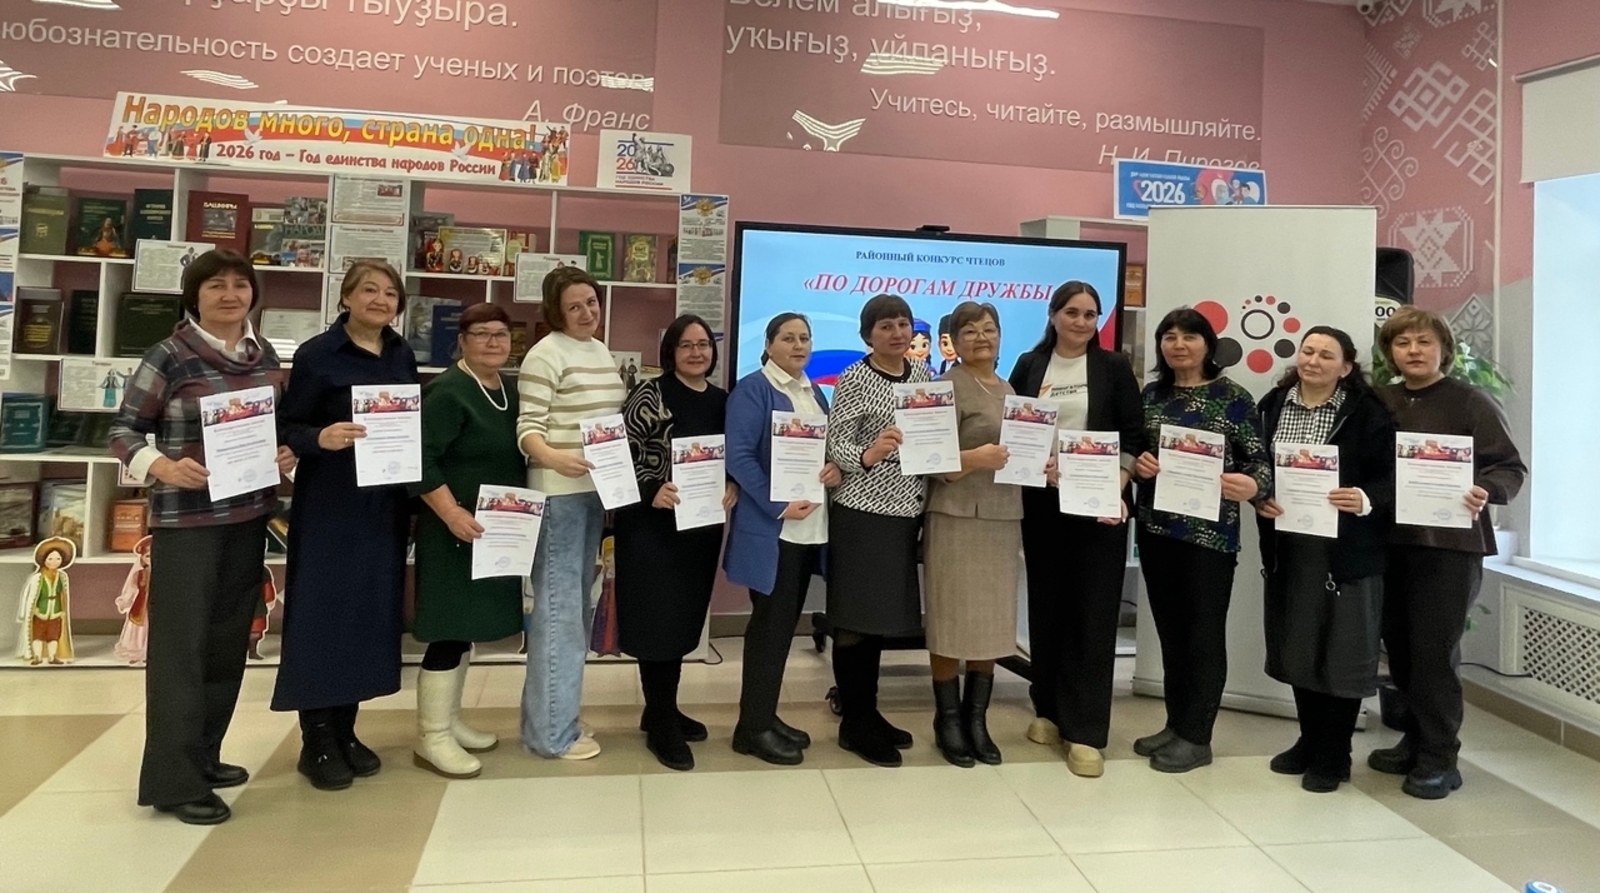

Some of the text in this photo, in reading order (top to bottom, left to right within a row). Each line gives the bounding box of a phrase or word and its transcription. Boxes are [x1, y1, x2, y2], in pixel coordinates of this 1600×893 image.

[1, 19, 278, 62] юбознательность
[288, 43, 405, 72] создает
[413, 52, 518, 81] ученых
[528, 64, 543, 83] и
[122, 95, 537, 151] Народов много, страна одна!
[562, 102, 651, 133] Франс
[871, 88, 1262, 141] Учитесь, читайте, размышляйте.
[216, 143, 255, 160] 2026
[259, 148, 281, 162] год
[299, 149, 322, 165] Год
[325, 155, 388, 169] единства
[391, 156, 445, 174] народов
[449, 158, 497, 176] России
[616, 157, 636, 171] 26
[617, 143, 636, 157] 20
[1141, 179, 1186, 205] 2026
[855, 250, 1006, 267] РАЙОННЫЙ КОНКУРС ЧТЕЦОВ
[803, 273, 1053, 301] «ПО ДОРОГАМ ДРУЖБЫ
